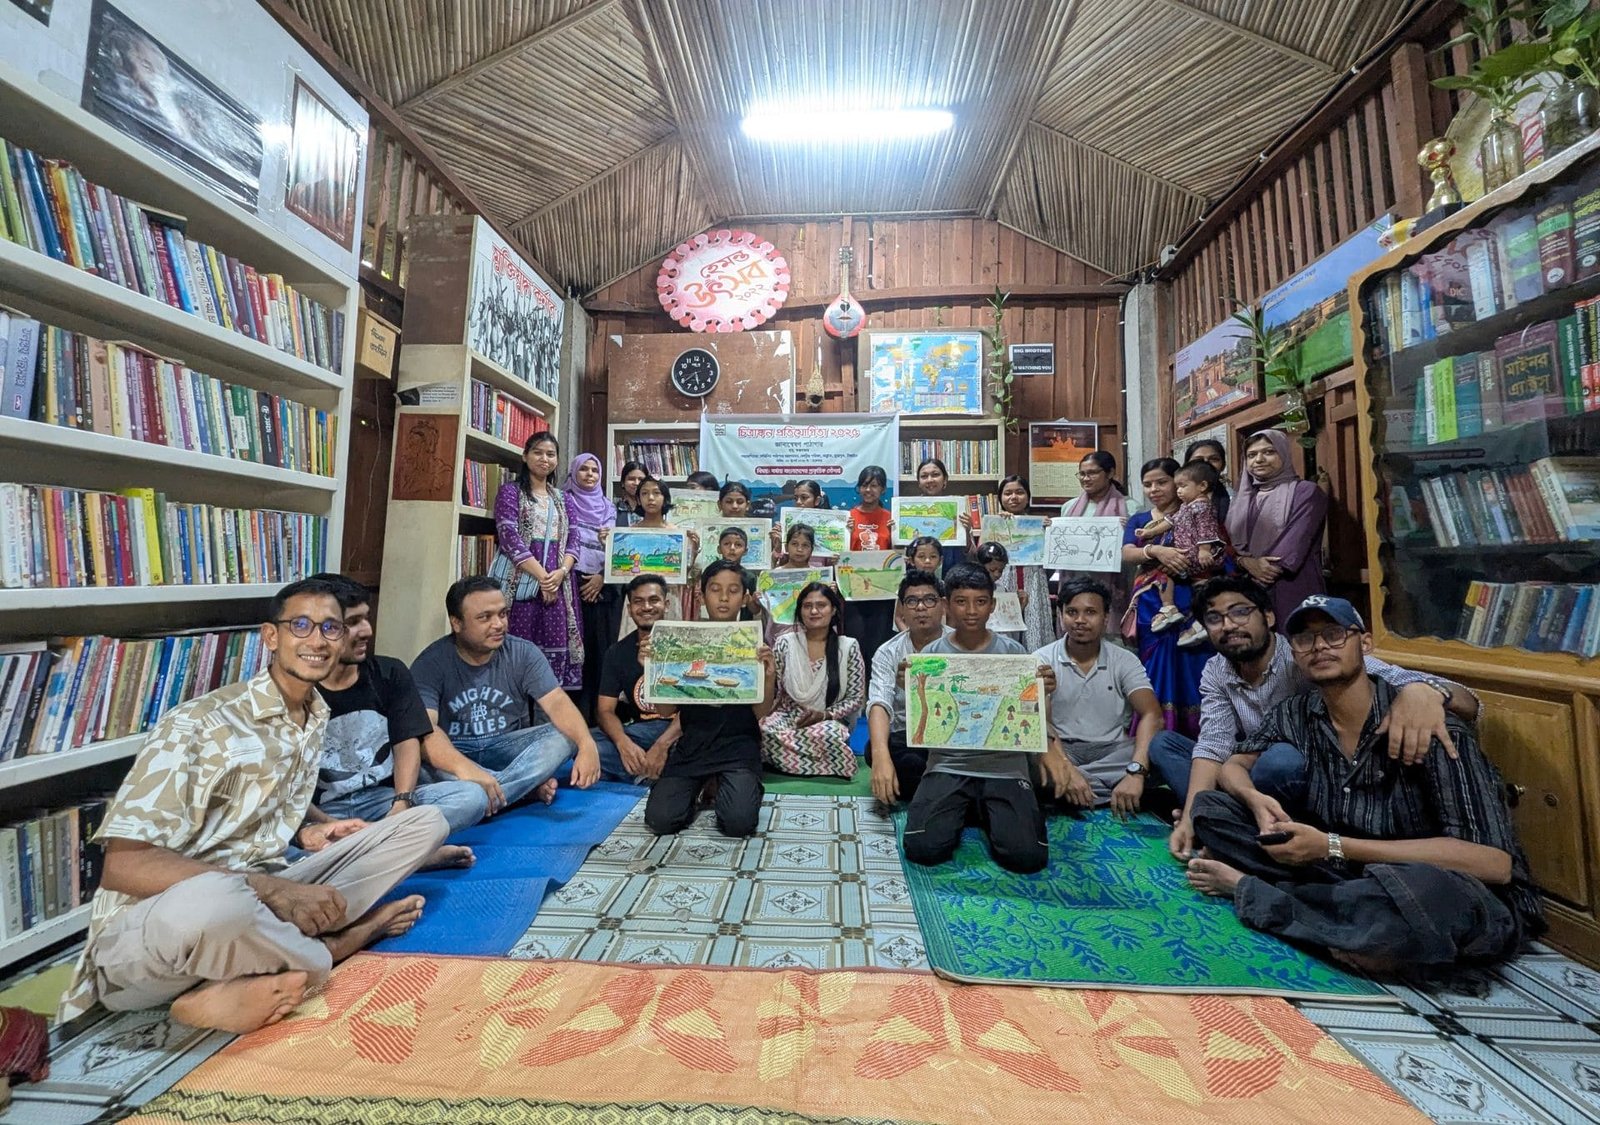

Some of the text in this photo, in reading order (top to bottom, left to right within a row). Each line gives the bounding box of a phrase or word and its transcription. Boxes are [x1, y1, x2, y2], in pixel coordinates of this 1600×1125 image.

[700, 250, 750, 279] হেমন্ত
[683, 259, 768, 309] উৎসব
[735, 284, 770, 302] ২০২২
[1505, 352, 1550, 377] মাইনর
[776, 425, 829, 438] প্রতিযোগিতা
[830, 429, 861, 438] ২০২৫
[1302, 595, 1330, 608] NY
[449, 687, 513, 712] MIGHTY
[450, 716, 506, 735] BLUES
